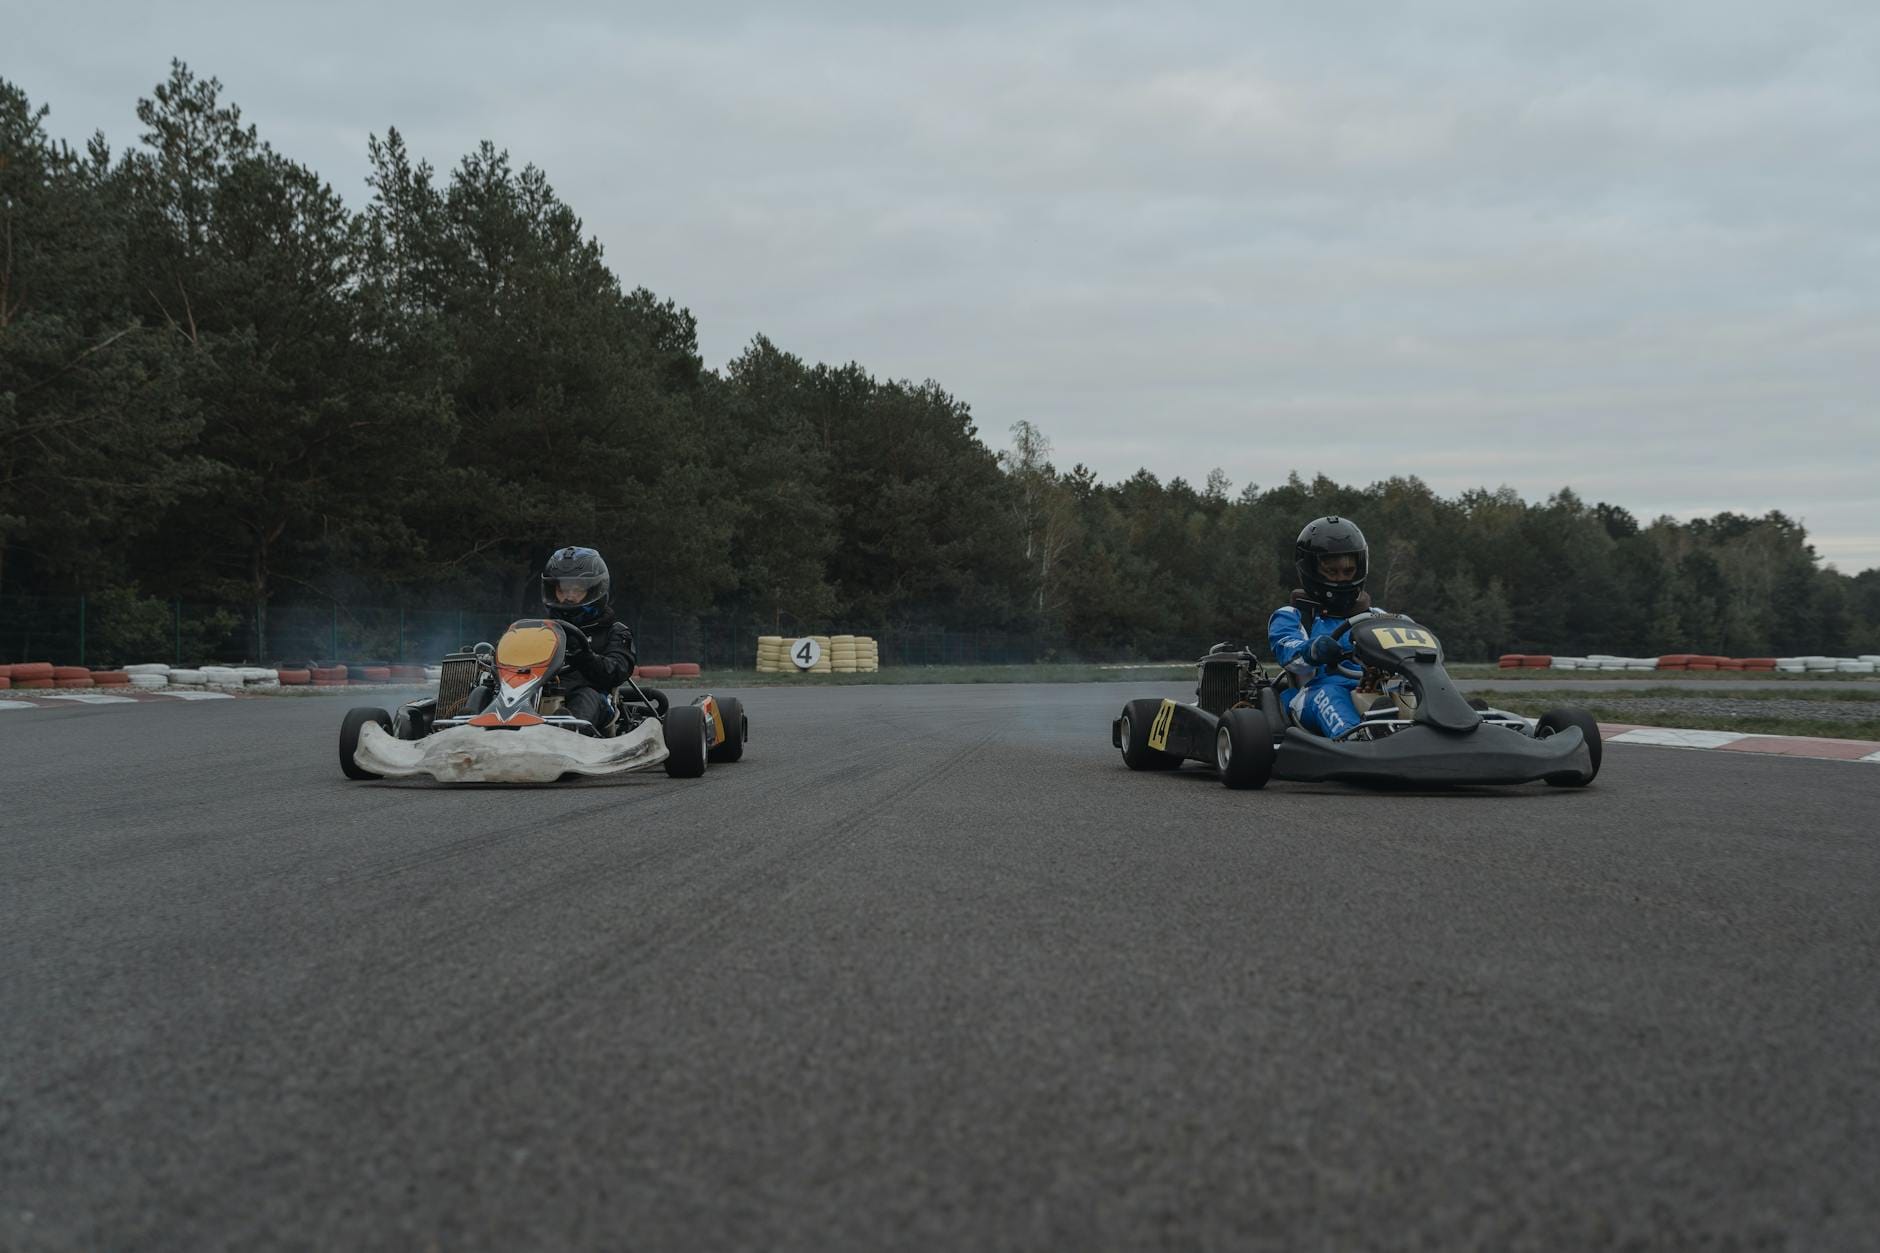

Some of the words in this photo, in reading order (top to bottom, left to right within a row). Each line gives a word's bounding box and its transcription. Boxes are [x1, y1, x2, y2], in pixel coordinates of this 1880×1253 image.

[1382, 628, 1427, 645] 14
[796, 641, 812, 664] 4
[1313, 689, 1344, 734] BREST
